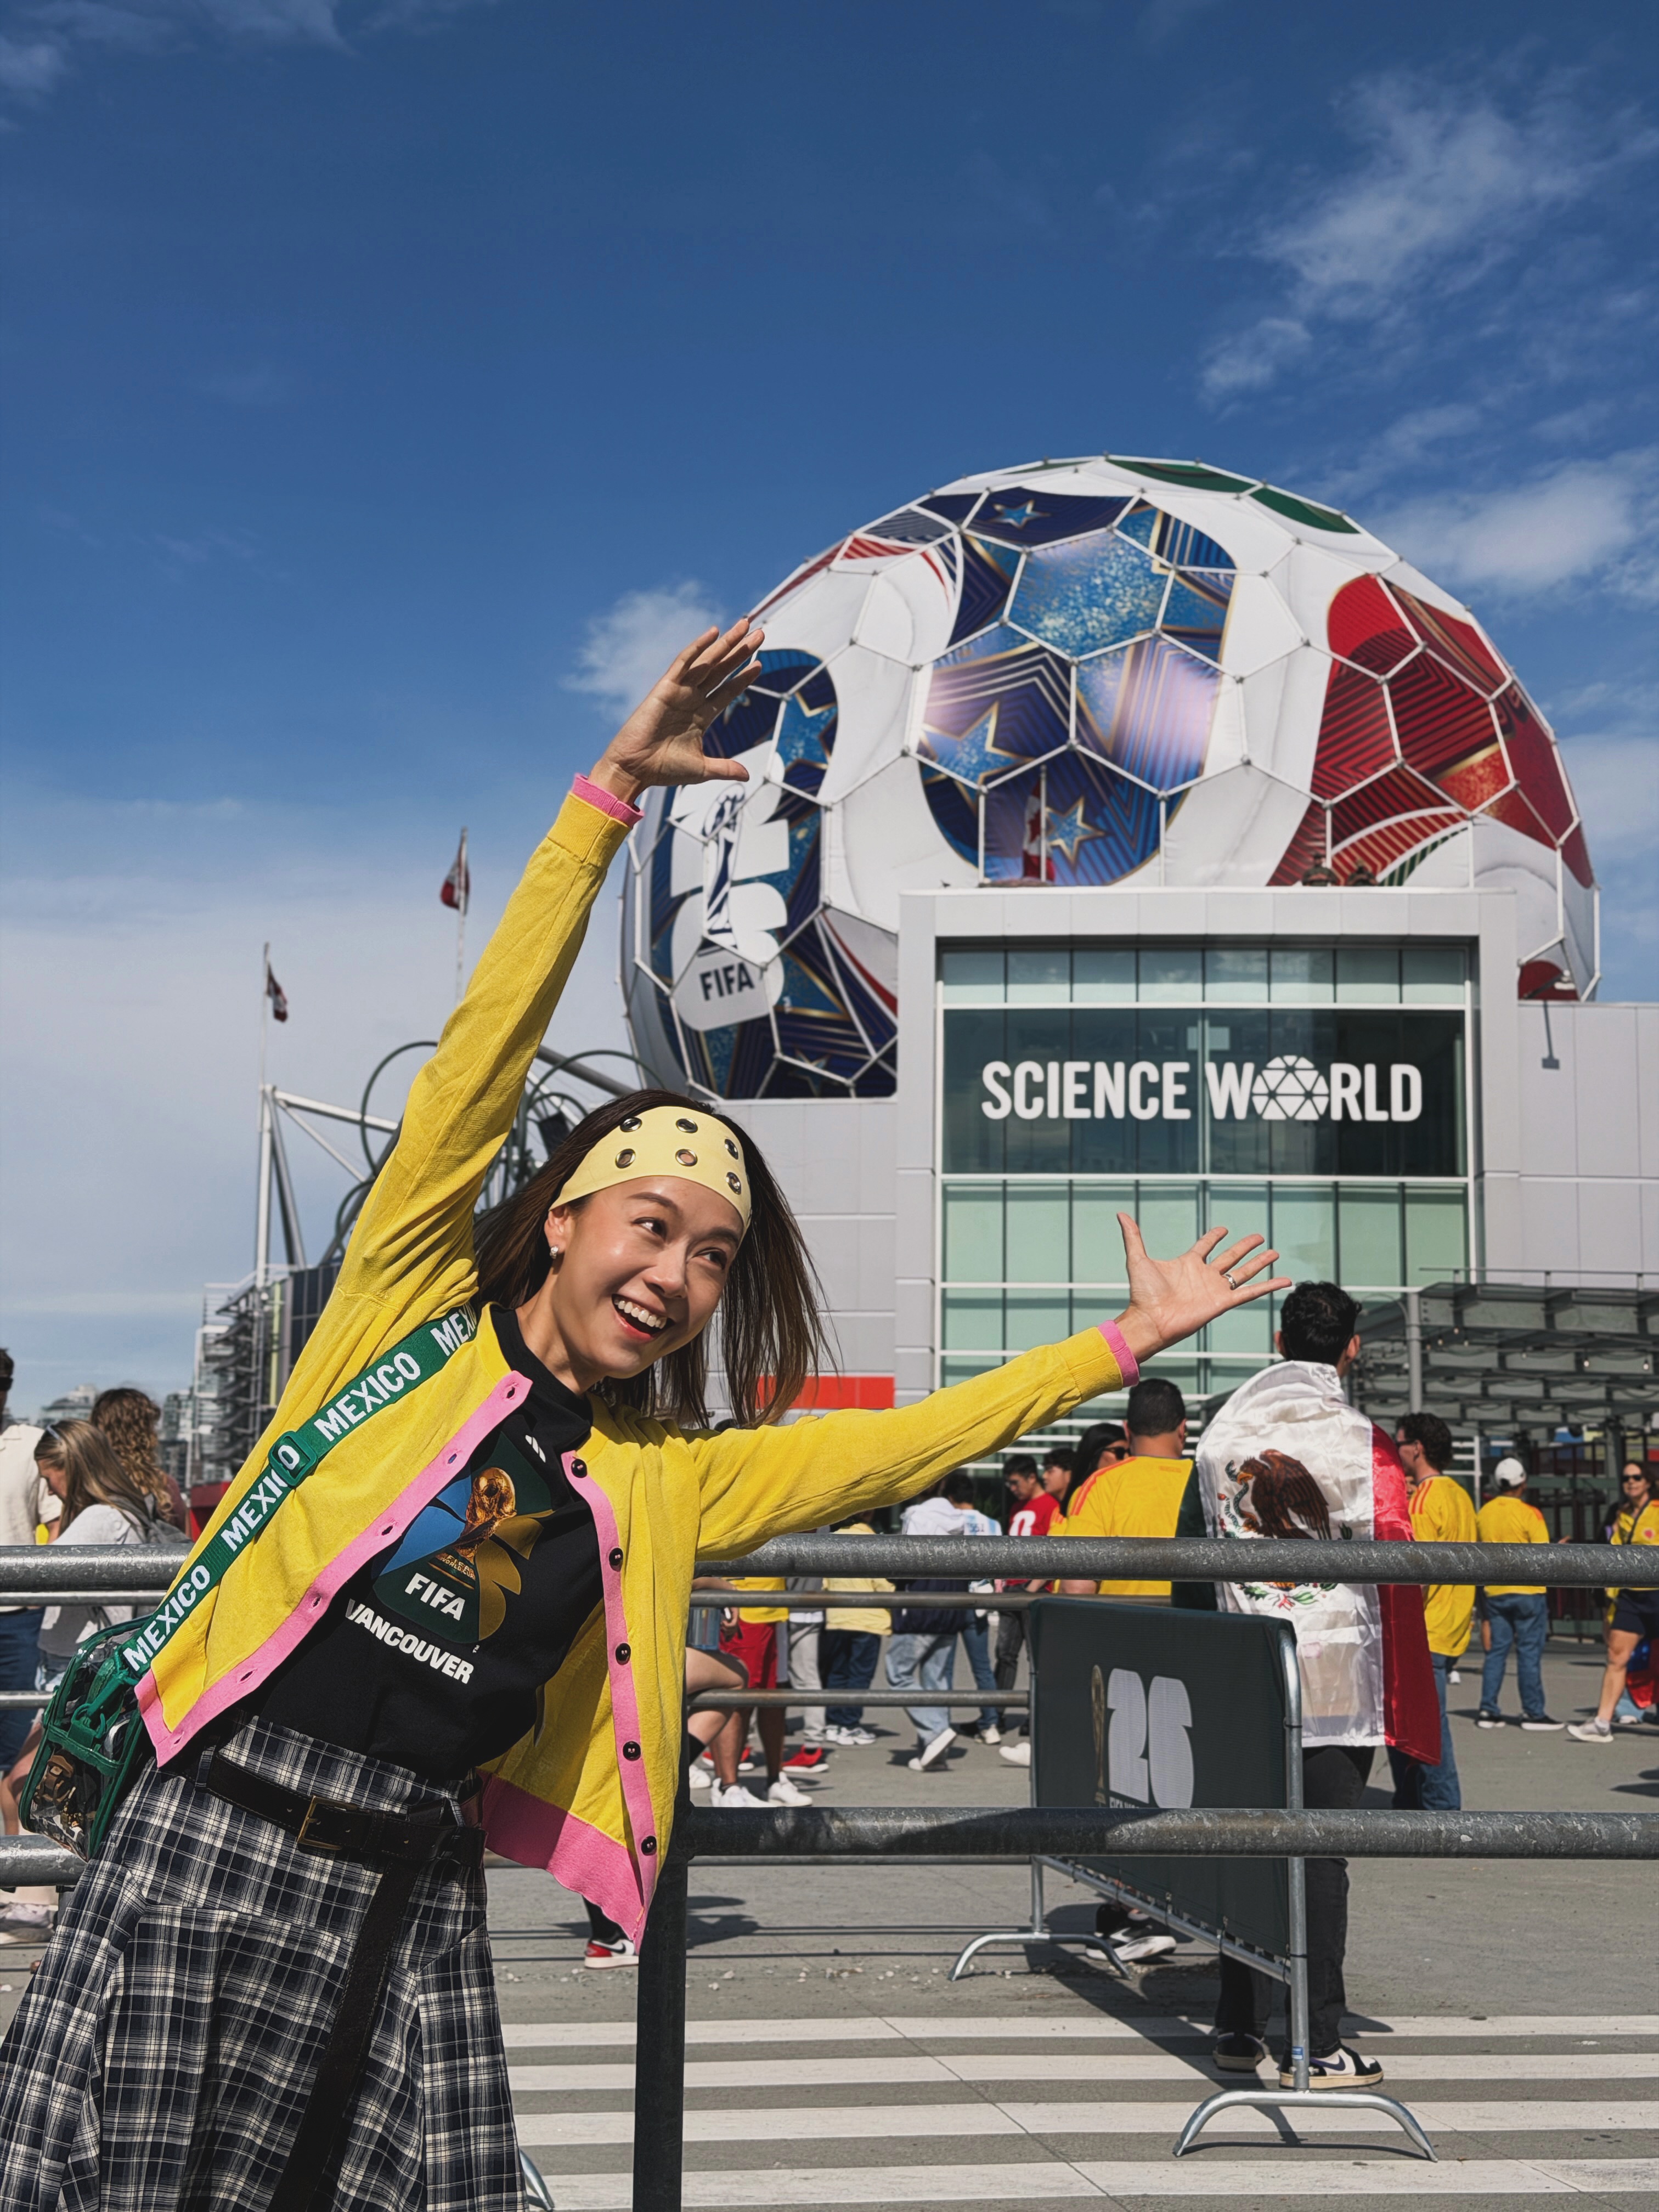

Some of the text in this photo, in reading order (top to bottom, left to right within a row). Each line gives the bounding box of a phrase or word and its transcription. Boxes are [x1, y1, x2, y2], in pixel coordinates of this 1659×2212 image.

[699, 962, 755, 1001] FIFA
[981, 1056, 1421, 1121] SCIENCE WORLD
[122, 1565, 211, 1672] MEXICO
[314, 1351, 421, 1442] MEXICO
[404, 1572, 465, 1621] FIFA
[345, 1599, 474, 1684] VANCOUVER
[1107, 1668, 1194, 1809] 26
